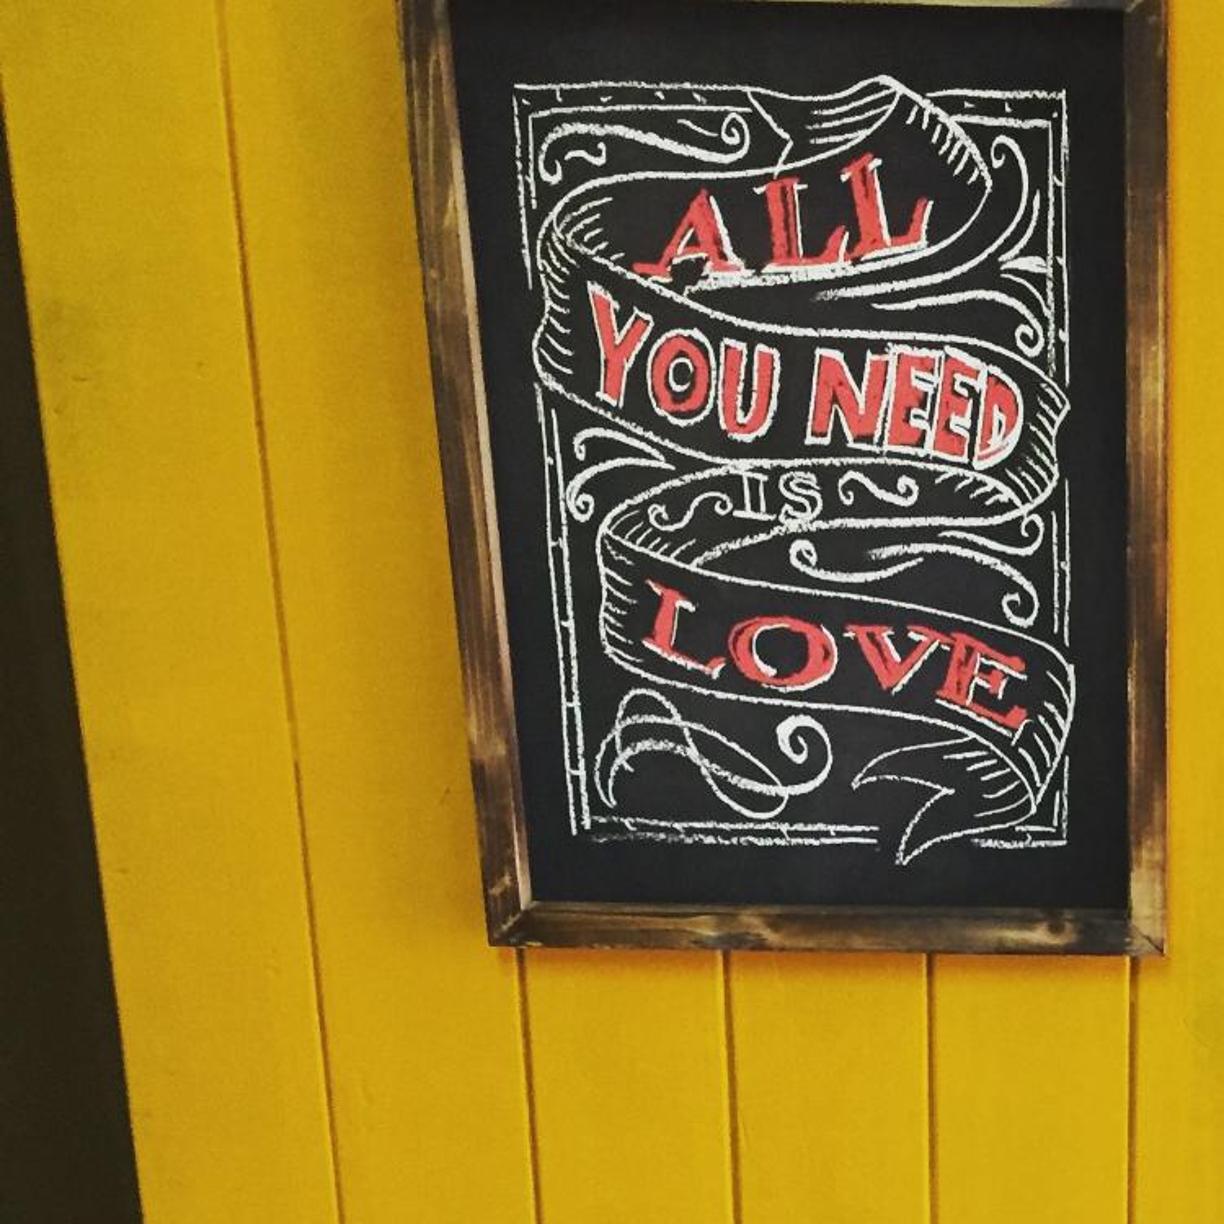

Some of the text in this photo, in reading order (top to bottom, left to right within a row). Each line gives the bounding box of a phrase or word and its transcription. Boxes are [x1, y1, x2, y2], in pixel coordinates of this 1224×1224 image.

[632, 152, 934, 284] ALL
[587, 281, 1024, 471] YOU NEED
[733, 471, 824, 525] IS
[643, 579, 1034, 745] LOVE
